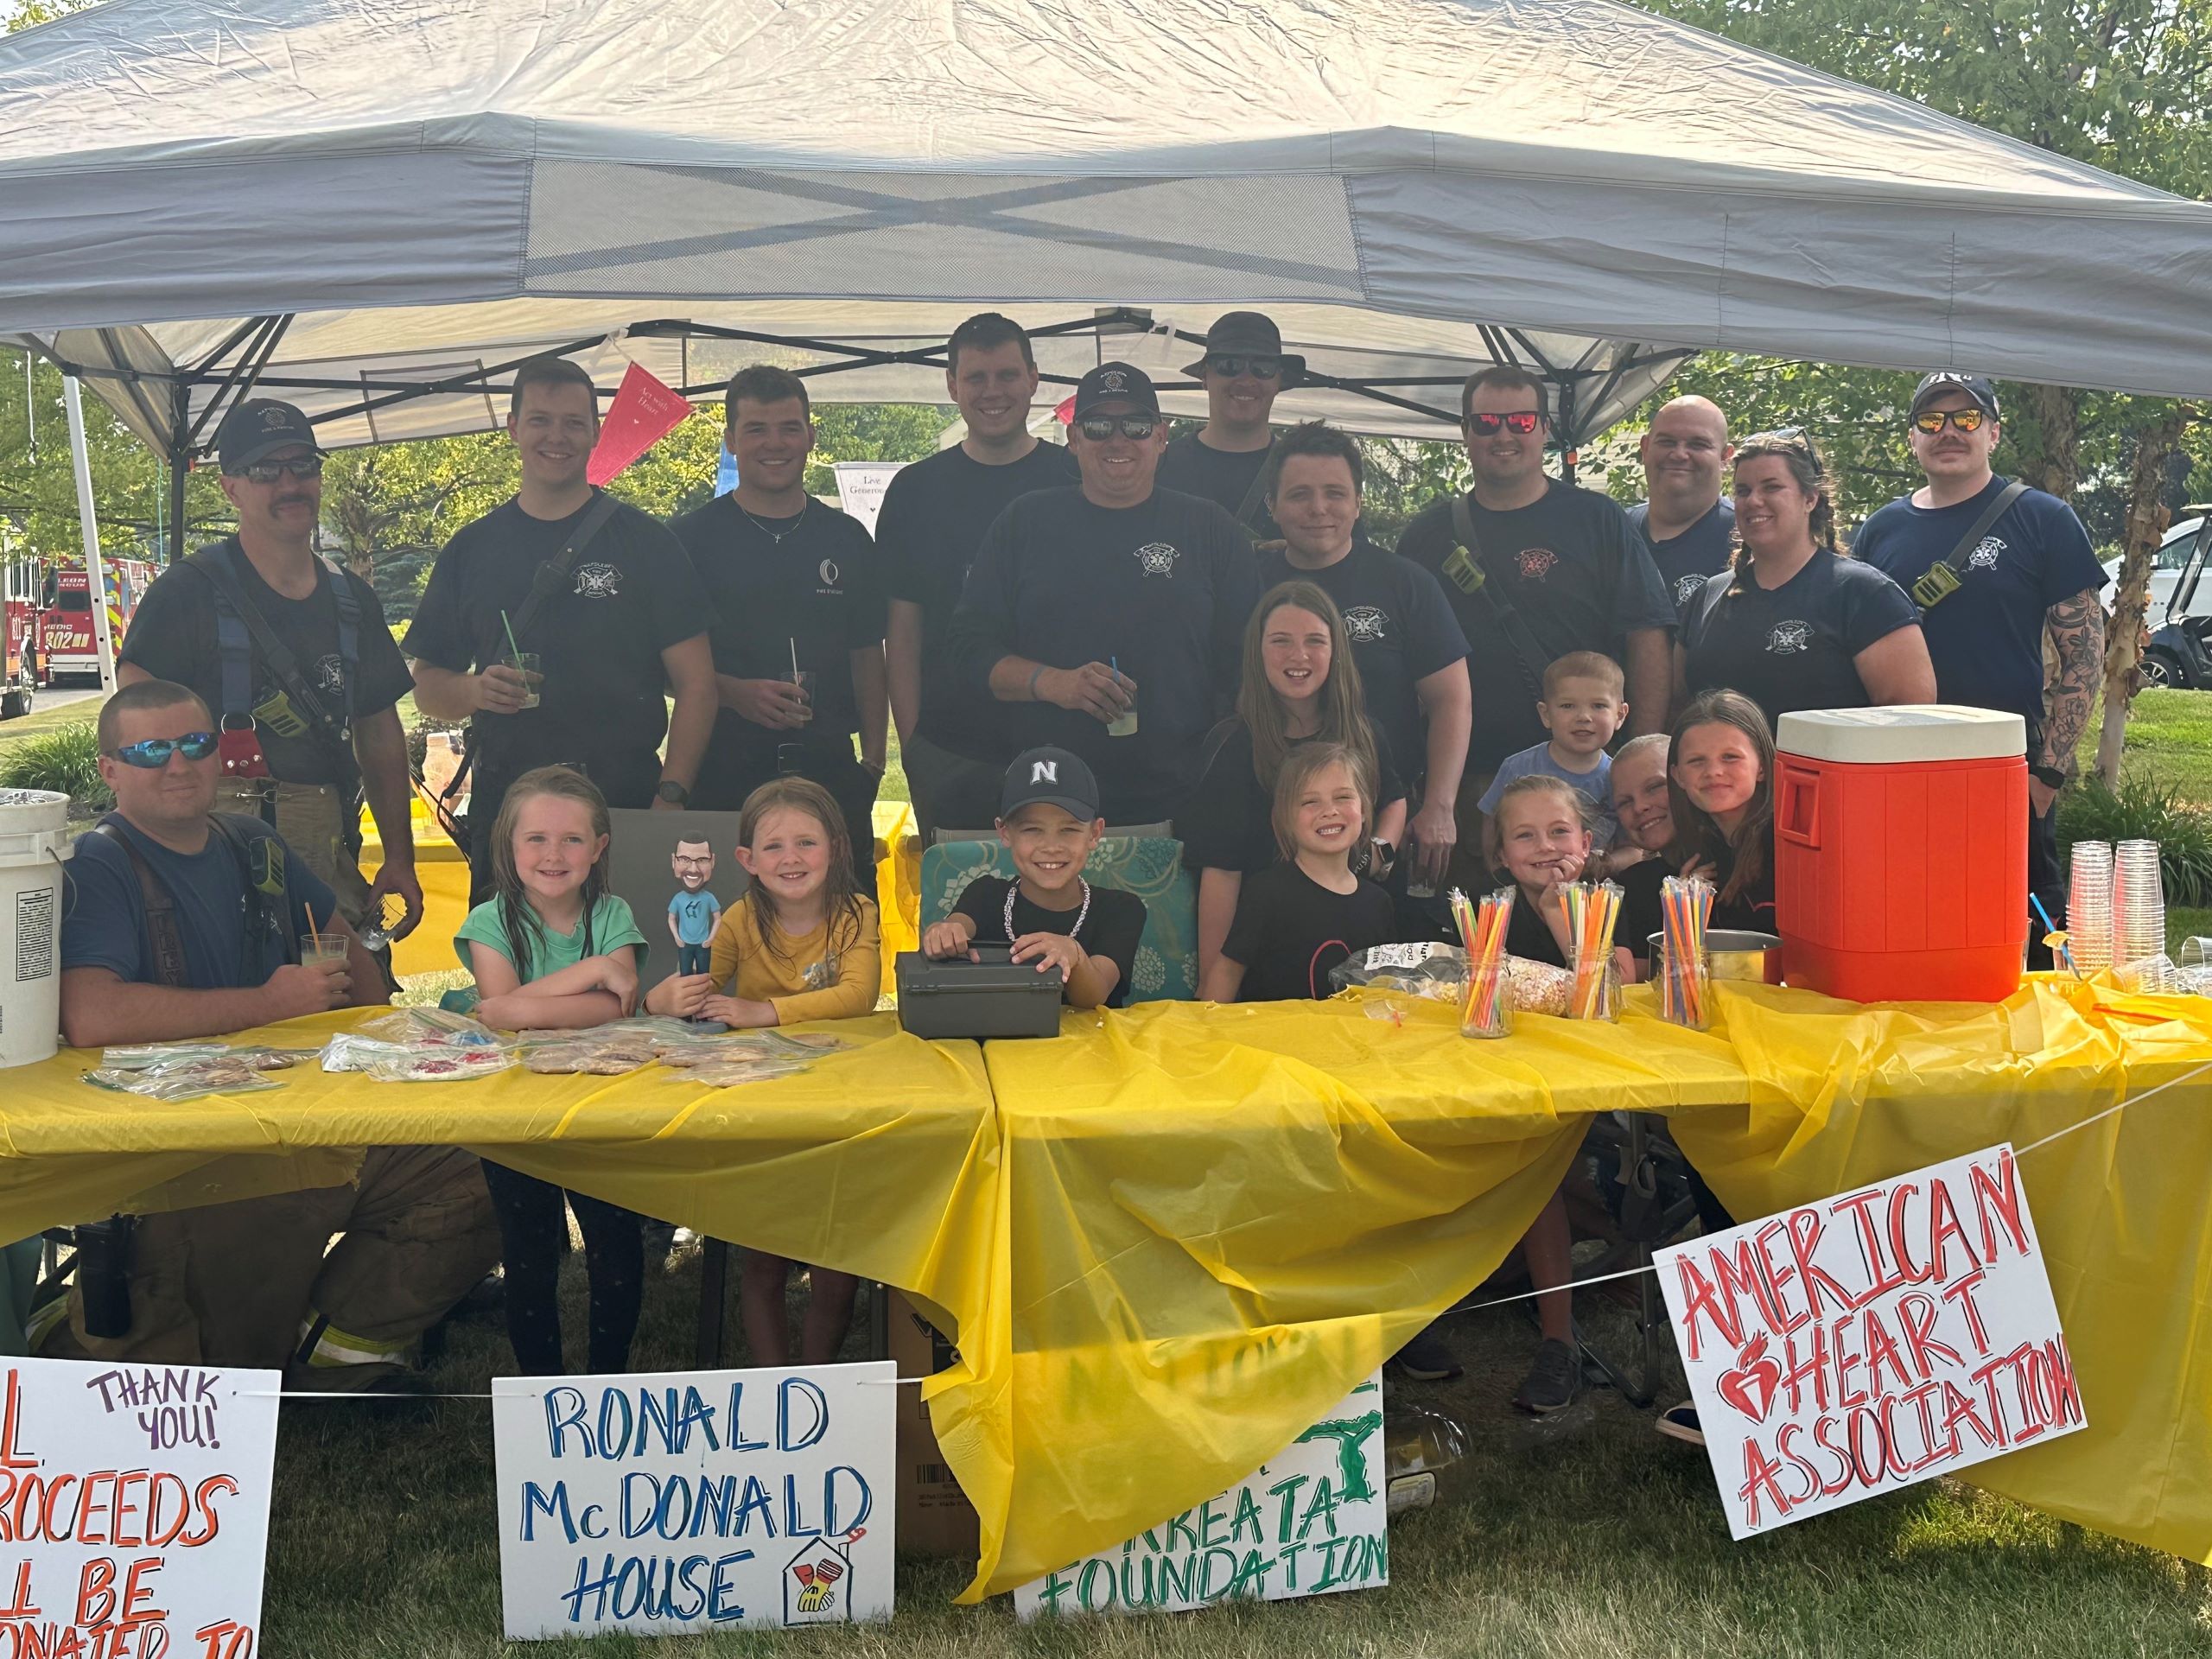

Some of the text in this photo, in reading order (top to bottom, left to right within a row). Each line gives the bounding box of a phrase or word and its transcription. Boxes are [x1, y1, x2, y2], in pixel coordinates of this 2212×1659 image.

[1030, 760, 1058, 785] N
[1675, 1147, 2031, 1362] AMERICAN
[1781, 1268, 1990, 1414] HEART
[86, 1368, 220, 1413] THANK
[138, 1405, 220, 1450] YOU!
[543, 1377, 830, 1461] RONALD
[1738, 1334, 2082, 1529] ASSOCIATION
[520, 1465, 873, 1543] McDONALD
[74, 1557, 169, 1627] BE
[561, 1549, 760, 1623] HOUSE
[1039, 1529, 1388, 1617] FOUNDATION
[195, 1618, 254, 1659] TO
